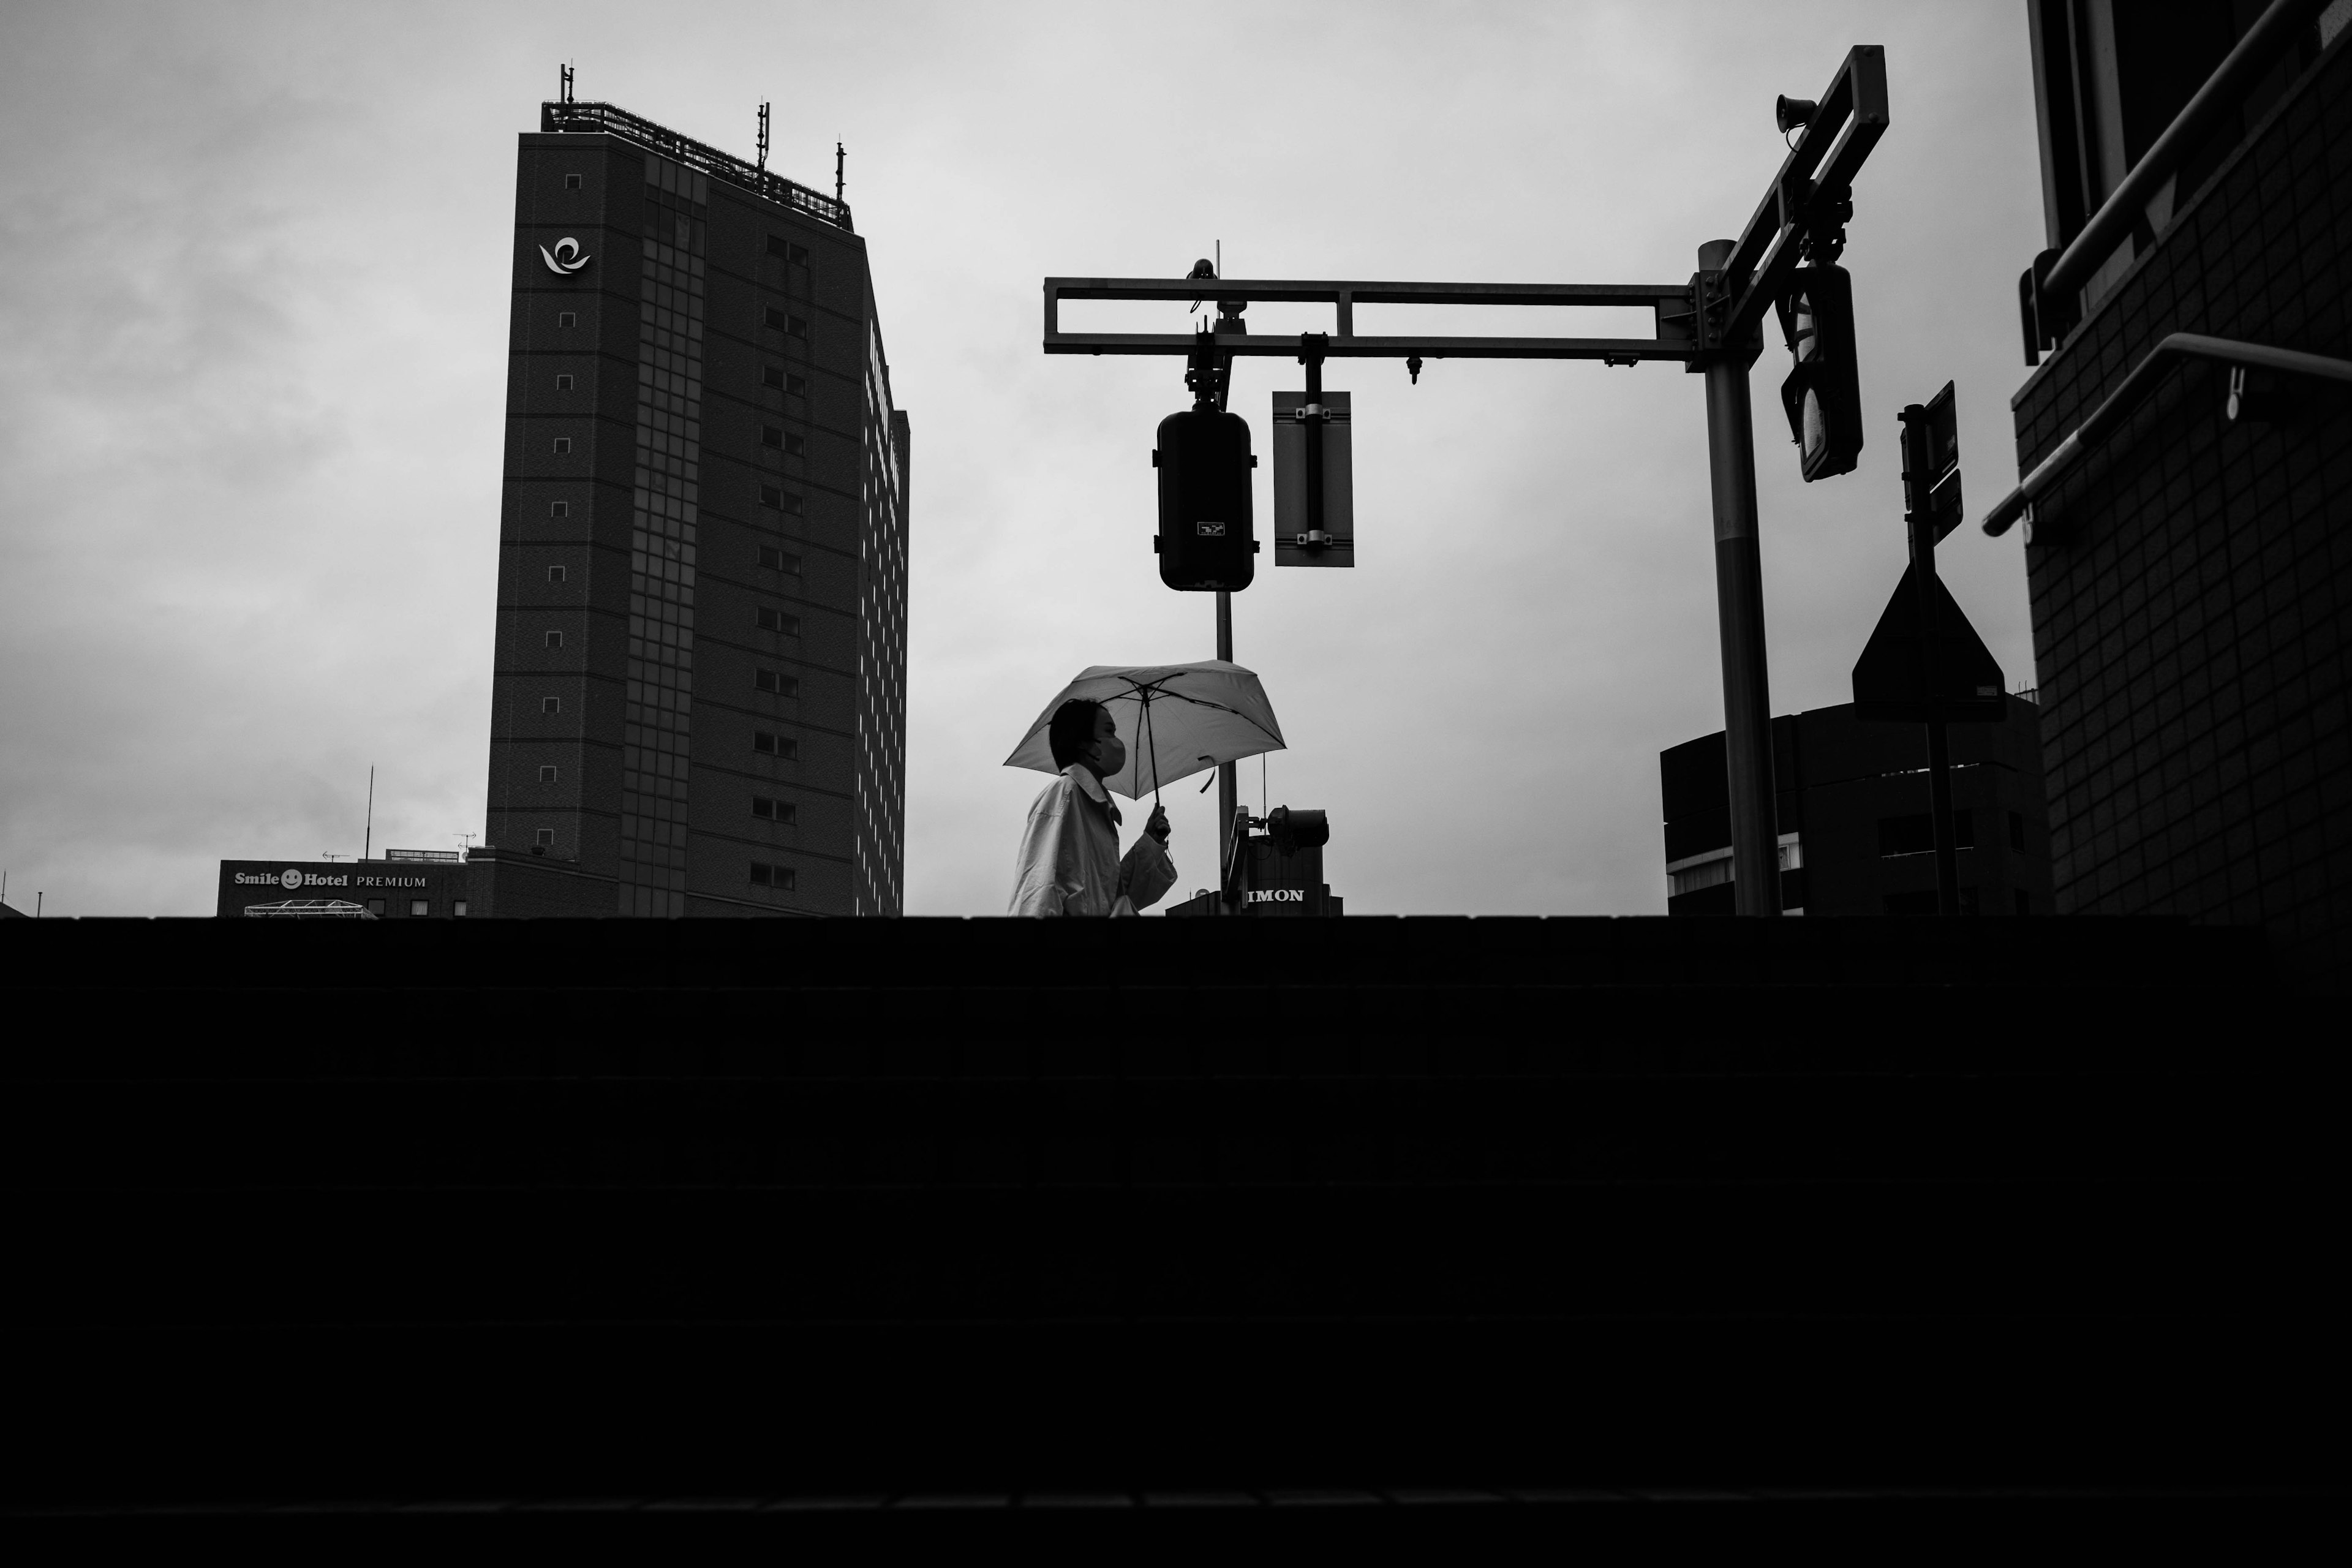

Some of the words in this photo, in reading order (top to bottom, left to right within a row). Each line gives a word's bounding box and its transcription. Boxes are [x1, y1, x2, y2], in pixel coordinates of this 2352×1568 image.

[235, 872, 280, 885] Smile
[304, 874, 348, 886] Hotel
[357, 876, 426, 888] PREMIUM
